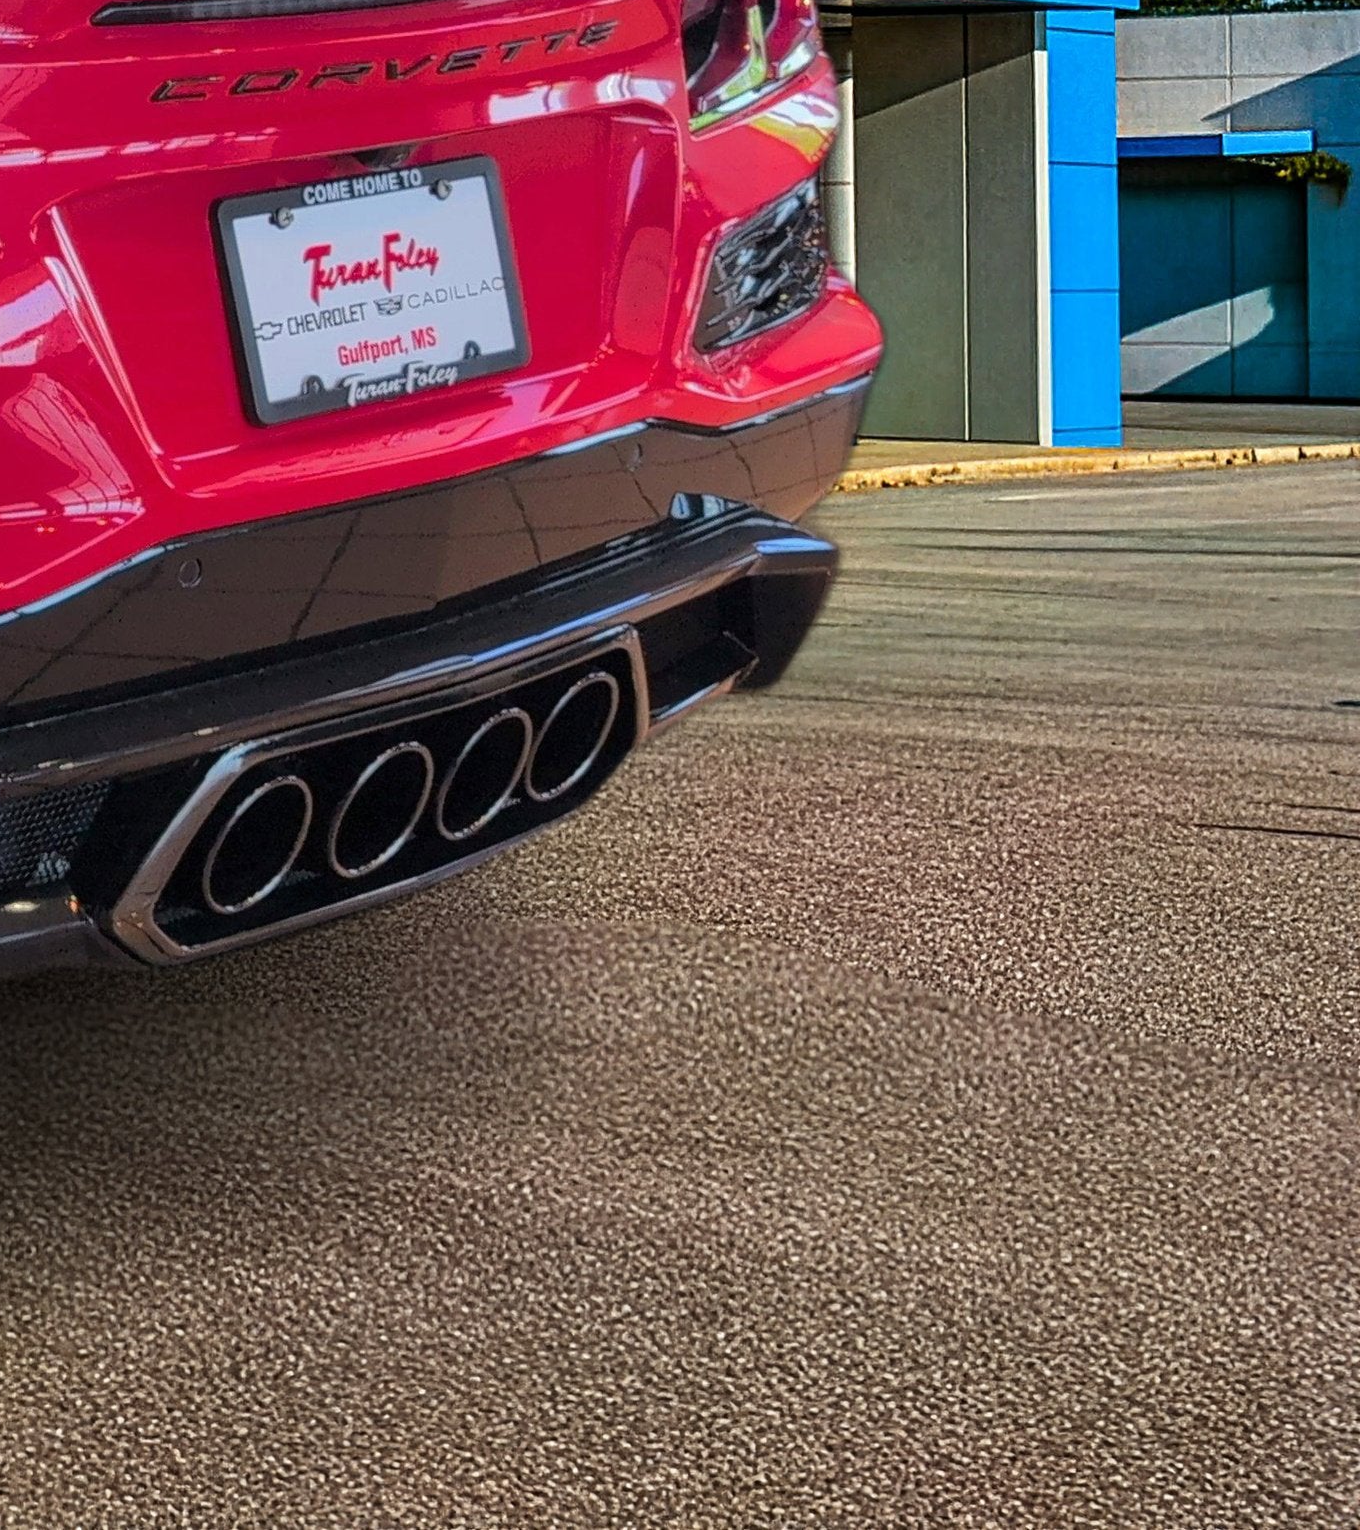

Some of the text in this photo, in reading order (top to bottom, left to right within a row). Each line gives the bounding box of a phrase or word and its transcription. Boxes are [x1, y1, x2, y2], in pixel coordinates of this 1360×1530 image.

[147, 20, 619, 104] CORVETTE
[302, 167, 423, 206] COME HOME TO
[286, 275, 506, 337] CHEVROLET CADILLAC
[337, 326, 437, 367] Gulfport, MS
